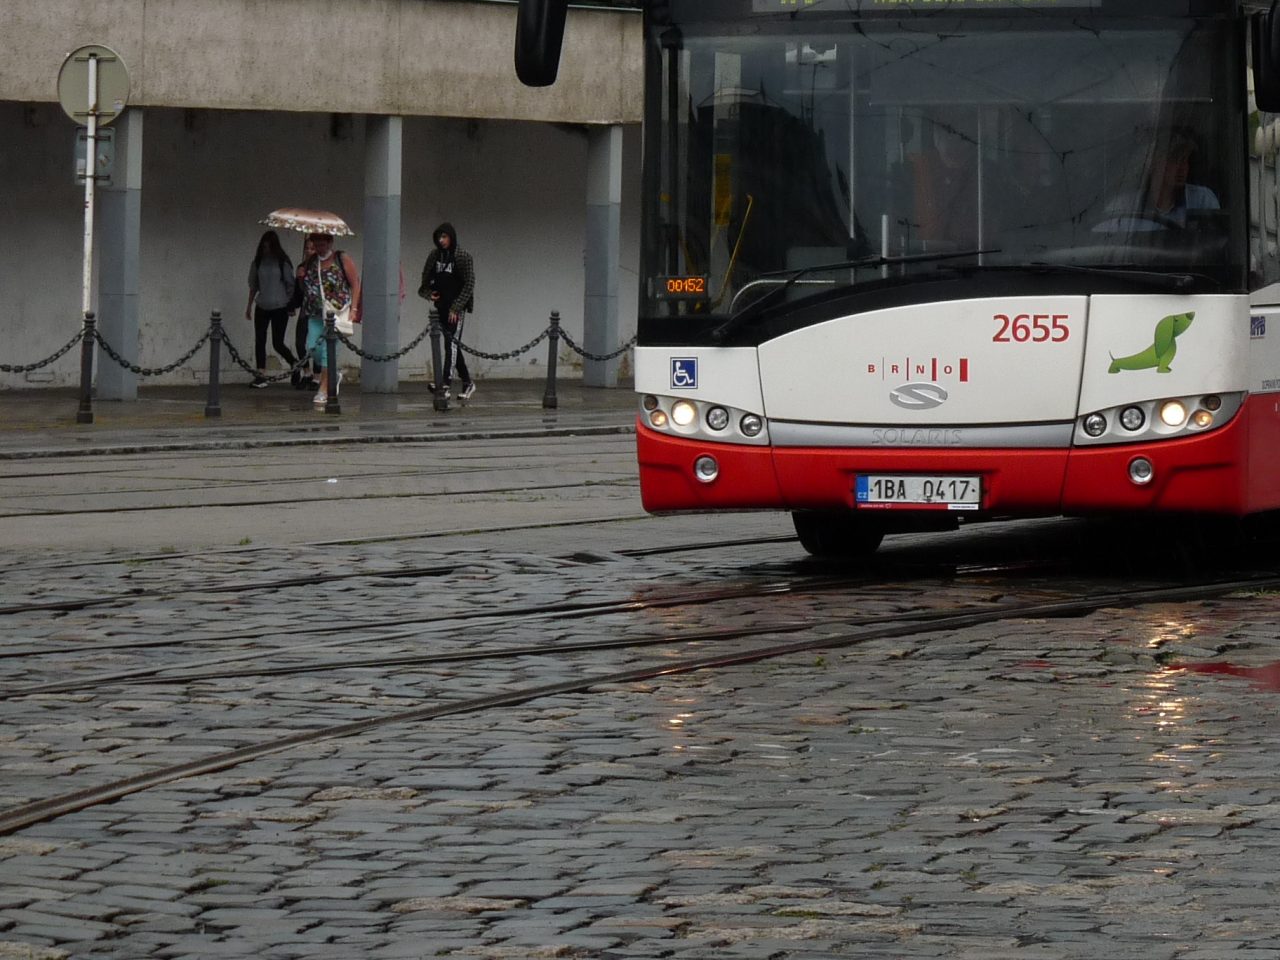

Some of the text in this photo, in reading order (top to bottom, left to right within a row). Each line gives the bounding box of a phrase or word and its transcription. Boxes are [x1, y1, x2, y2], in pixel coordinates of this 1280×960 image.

[667, 278, 704, 292] 00152
[992, 314, 1070, 343] 2655
[871, 428, 963, 445] SOLARIS
[873, 479, 906, 499] 1BA
[923, 480, 970, 500] 0417
